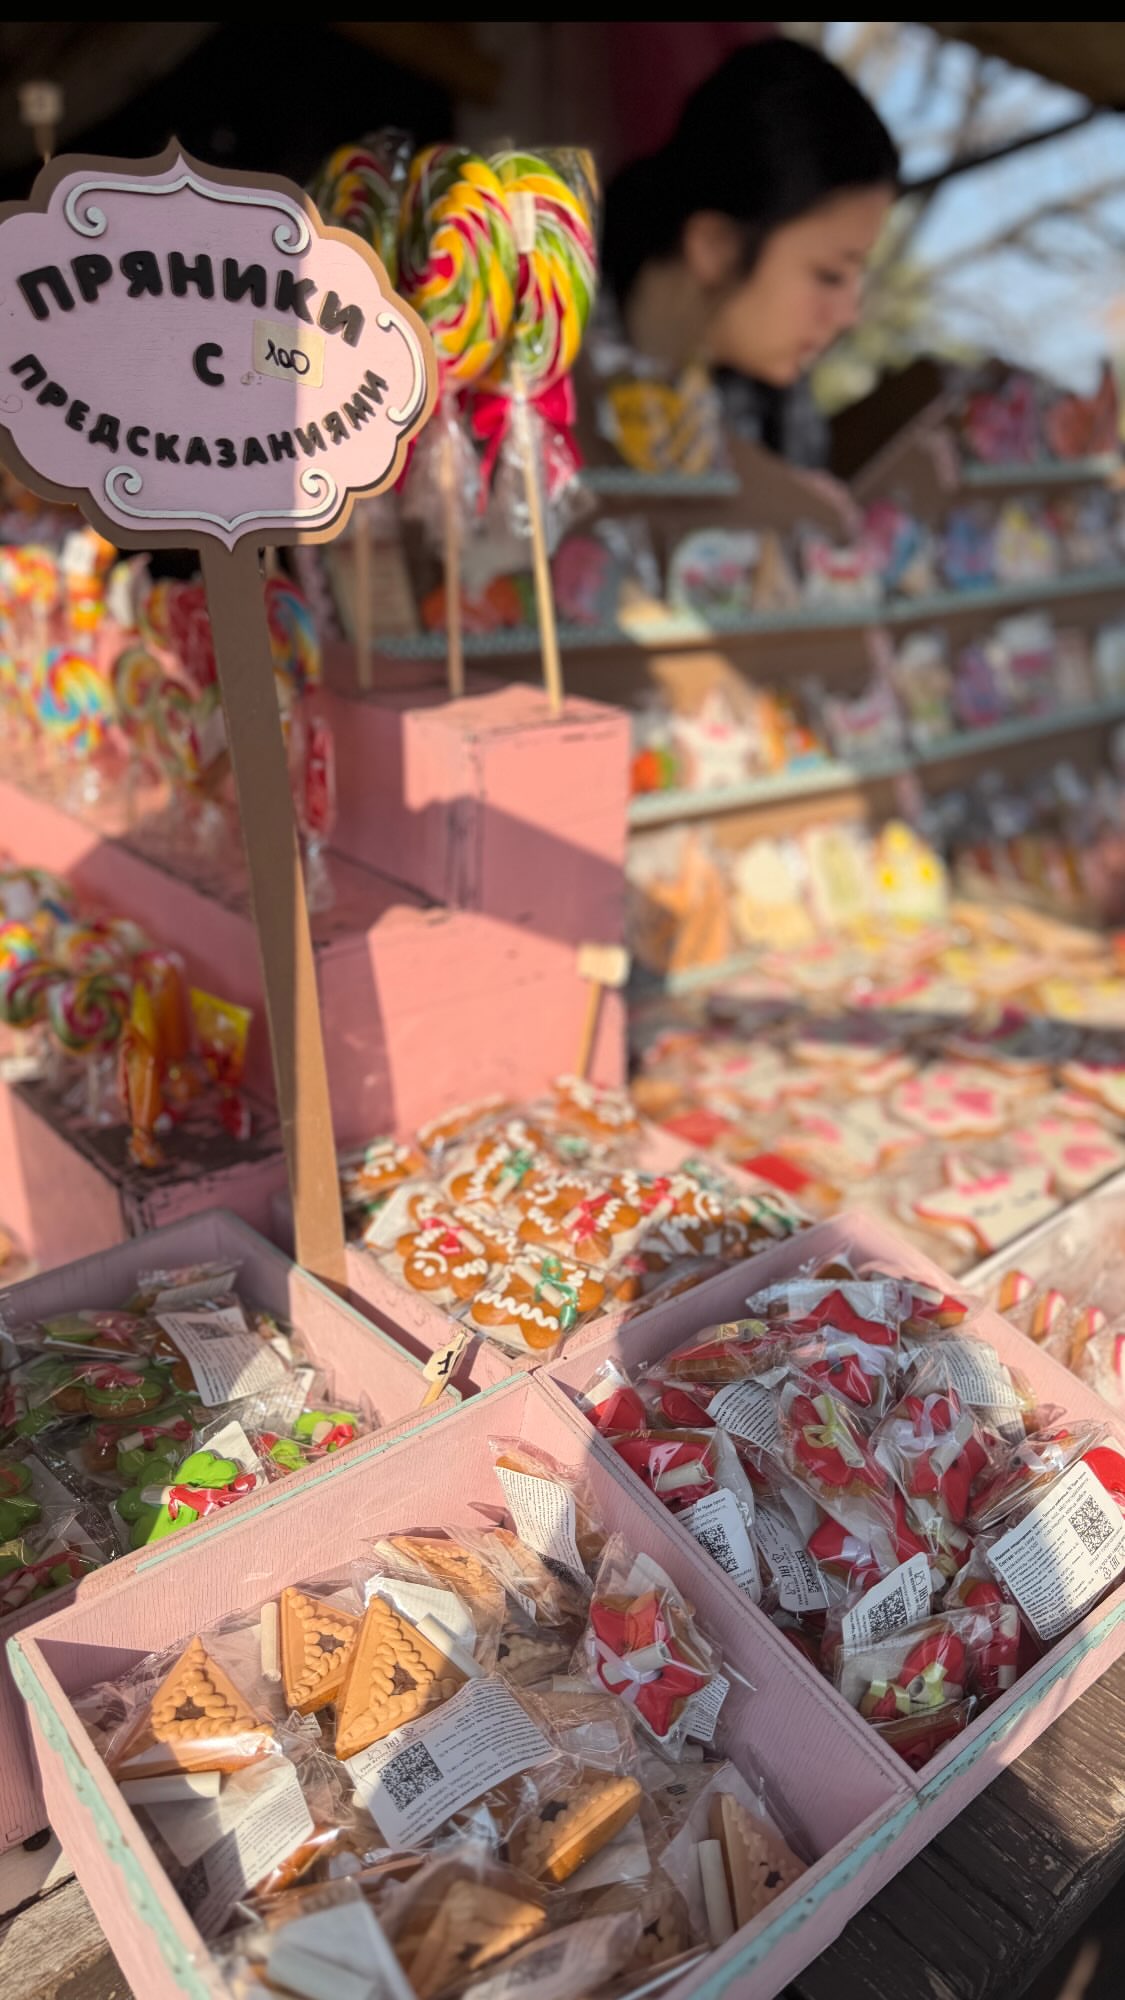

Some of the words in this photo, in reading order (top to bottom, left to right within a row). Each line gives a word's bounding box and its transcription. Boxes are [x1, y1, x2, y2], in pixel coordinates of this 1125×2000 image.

[18, 250, 366, 347] ПРЯНИКИ
[193, 342, 225, 387] С
[265, 339, 310, 375] 100
[10, 353, 389, 468] ПРЕДСКАЗАНИЯМИ
